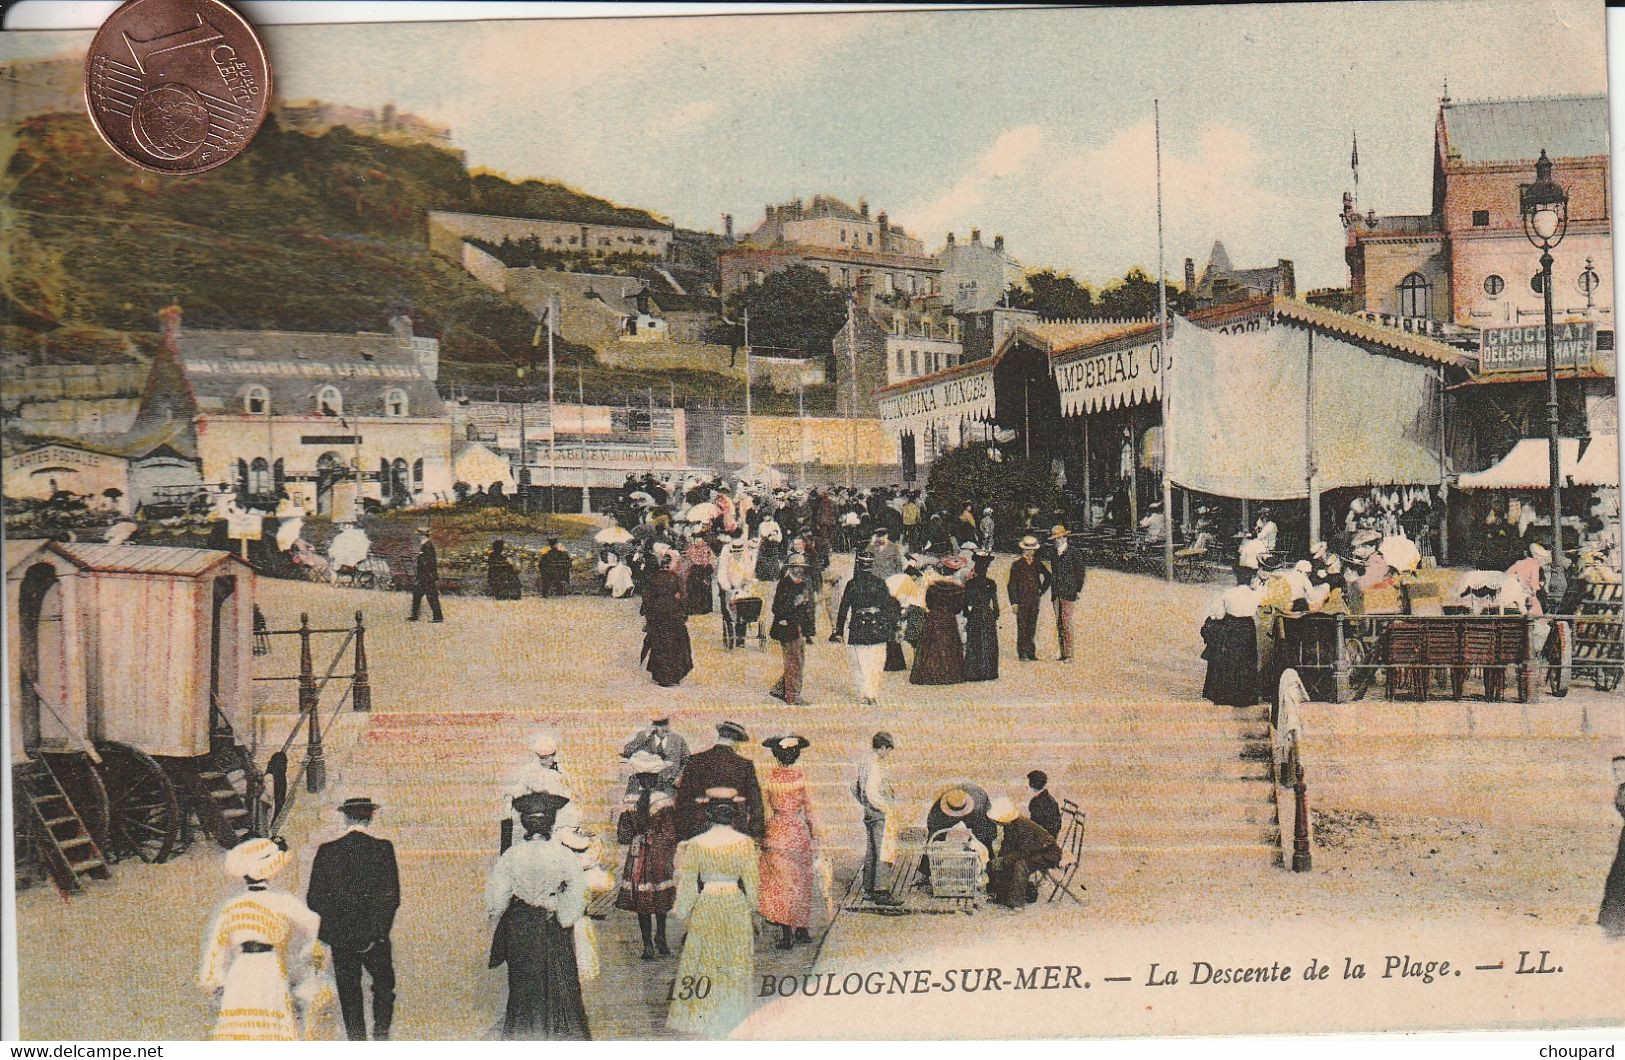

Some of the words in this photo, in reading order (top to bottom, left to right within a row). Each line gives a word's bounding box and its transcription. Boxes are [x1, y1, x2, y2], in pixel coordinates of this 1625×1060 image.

[122, 13, 224, 75] 1
[1058, 350, 1140, 393] IMPERIAL
[665, 974, 711, 1001] 130
[758, 966, 1091, 997] BOULOGNE-SUR-MER.
[1145, 964, 1178, 986] La
[1190, 960, 1291, 984] Descente
[1303, 958, 1330, 981] de
[1344, 957, 1366, 979] la
[1382, 955, 1462, 983] Plage.
[1515, 951, 1564, 975] LL.
